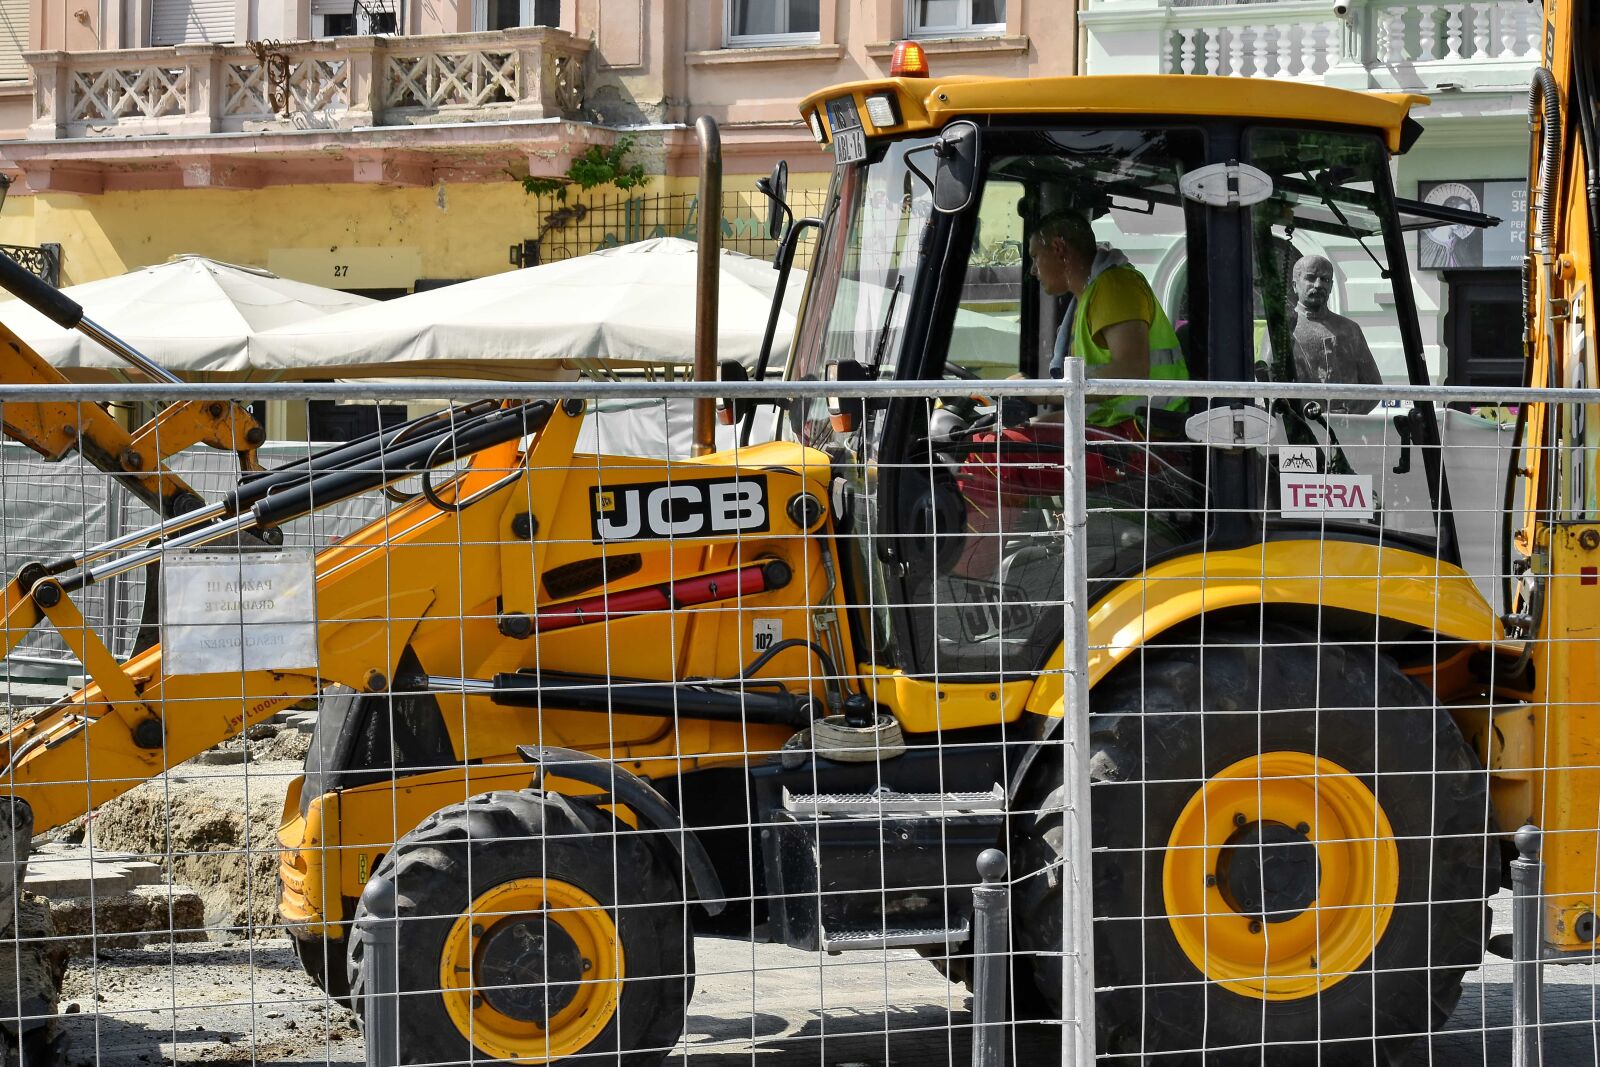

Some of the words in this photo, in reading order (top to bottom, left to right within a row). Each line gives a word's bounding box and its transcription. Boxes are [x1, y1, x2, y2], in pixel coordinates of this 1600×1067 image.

[334, 265, 349, 277] 27
[1287, 484, 1366, 507] TERRA
[597, 481, 766, 539] JCB
[755, 633, 773, 649] 102
